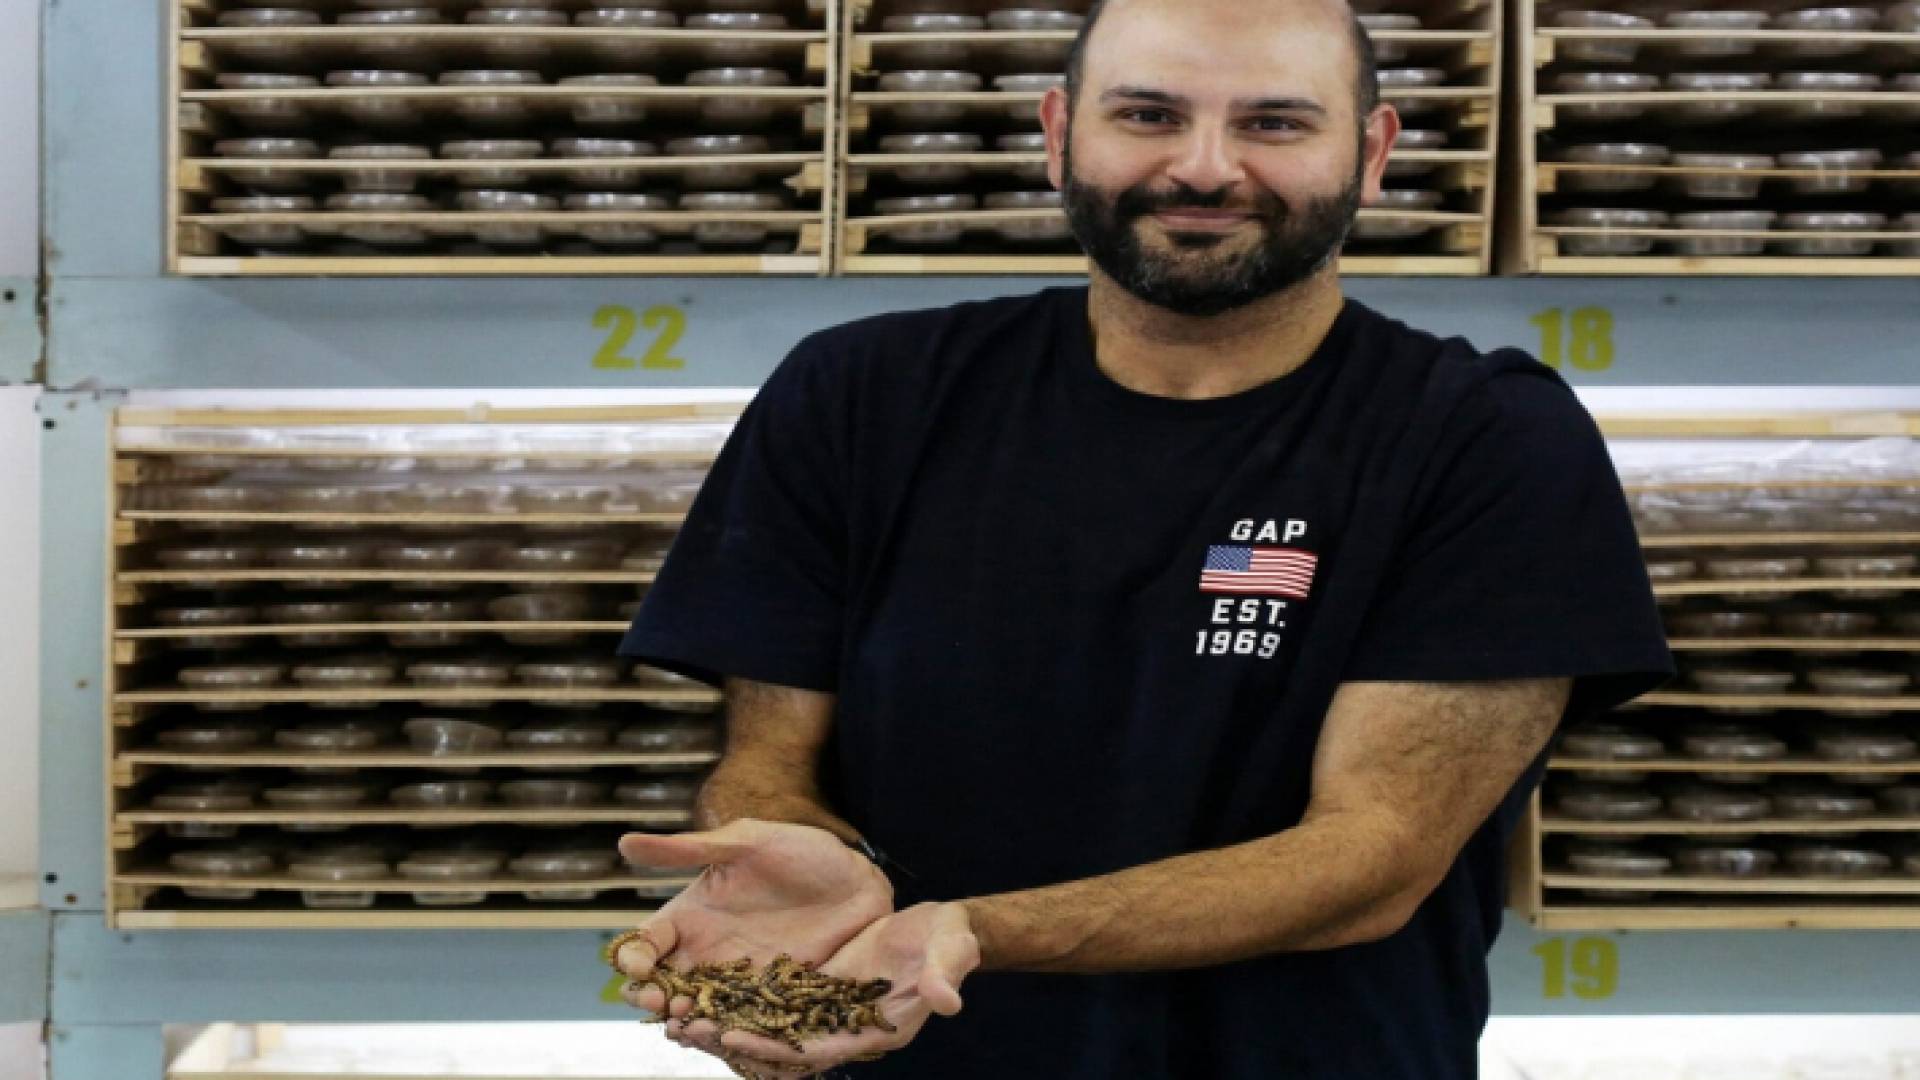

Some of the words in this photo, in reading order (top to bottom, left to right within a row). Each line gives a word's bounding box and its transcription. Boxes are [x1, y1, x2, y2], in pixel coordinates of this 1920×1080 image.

[592, 305, 686, 370] 22
[1531, 306, 1614, 371] 18
[1230, 518, 1308, 543] GAP
[1211, 598, 1287, 627] EST.
[1196, 629, 1281, 659] 1969
[1532, 936, 1619, 1001] 19
